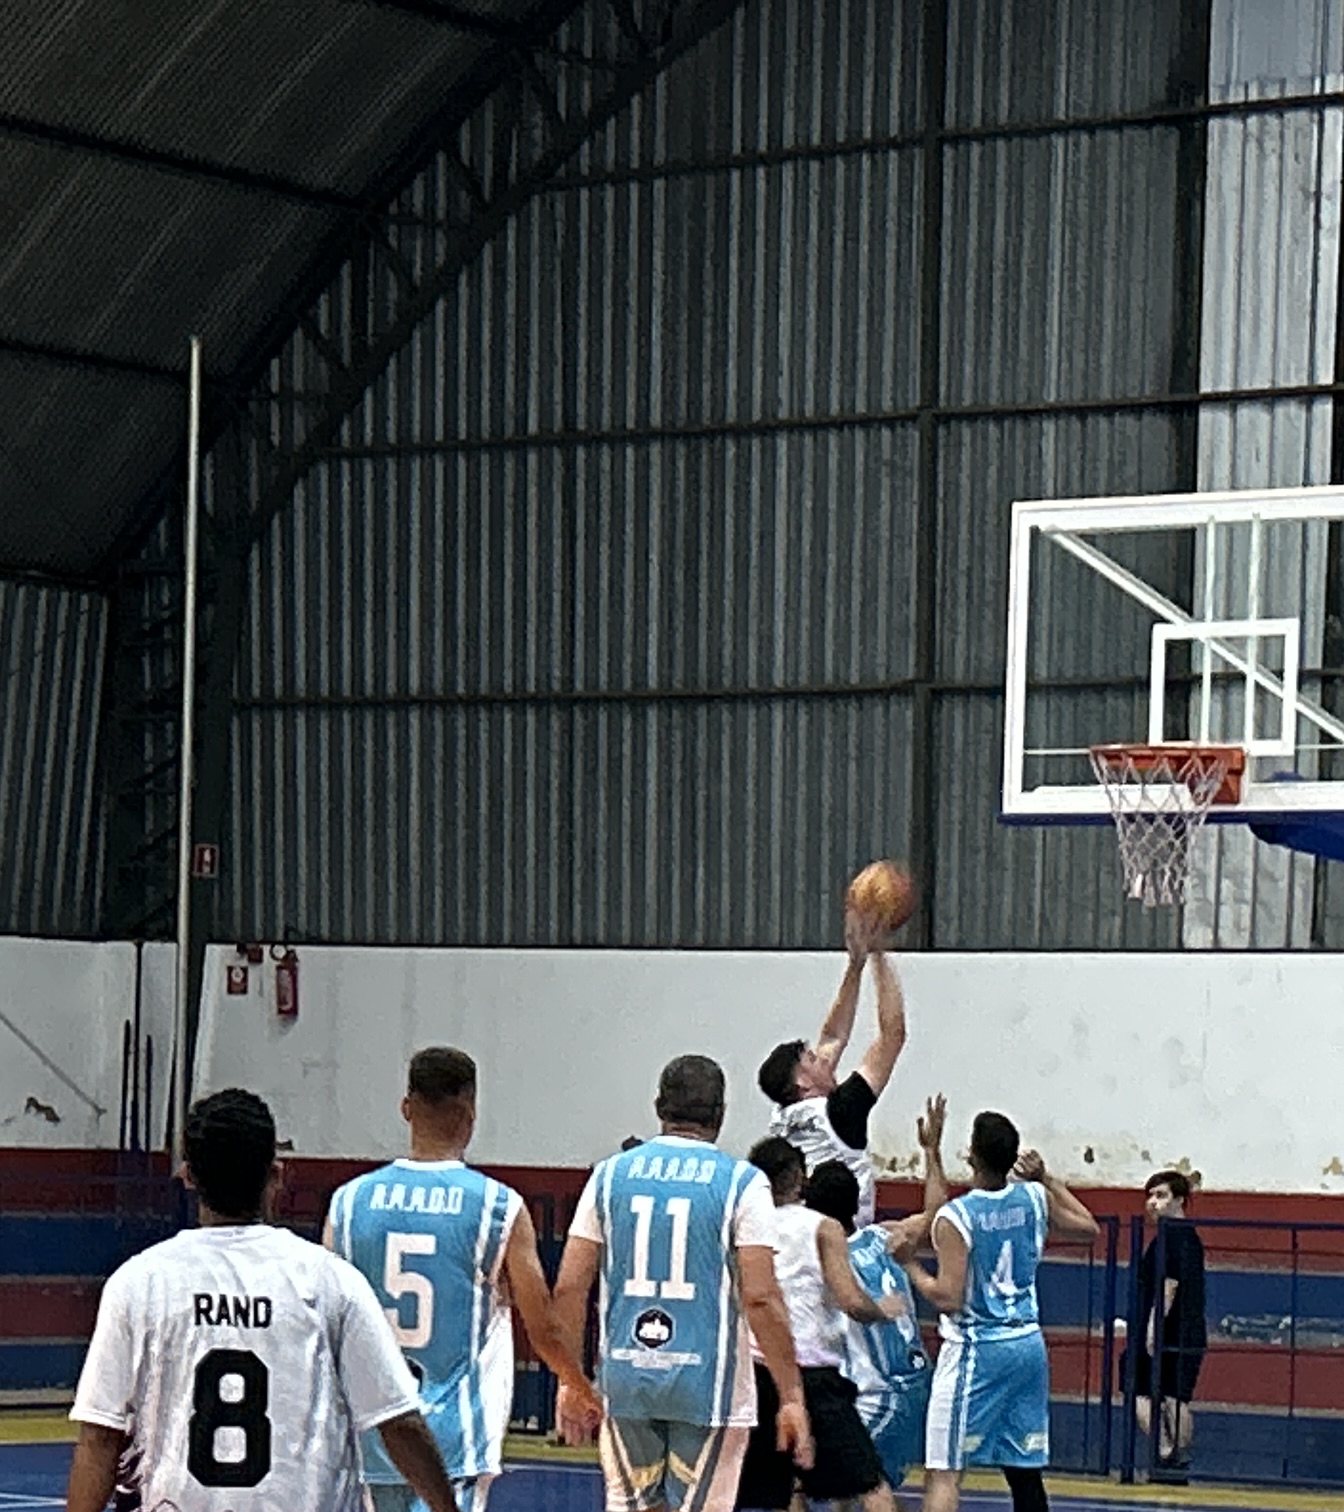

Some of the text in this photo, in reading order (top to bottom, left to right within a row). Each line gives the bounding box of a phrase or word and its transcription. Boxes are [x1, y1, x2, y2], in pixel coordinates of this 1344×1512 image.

[385, 1231, 437, 1348] 5
[624, 1194, 696, 1301] 11
[193, 1293, 272, 1330] RAND
[188, 1348, 272, 1488] 8
